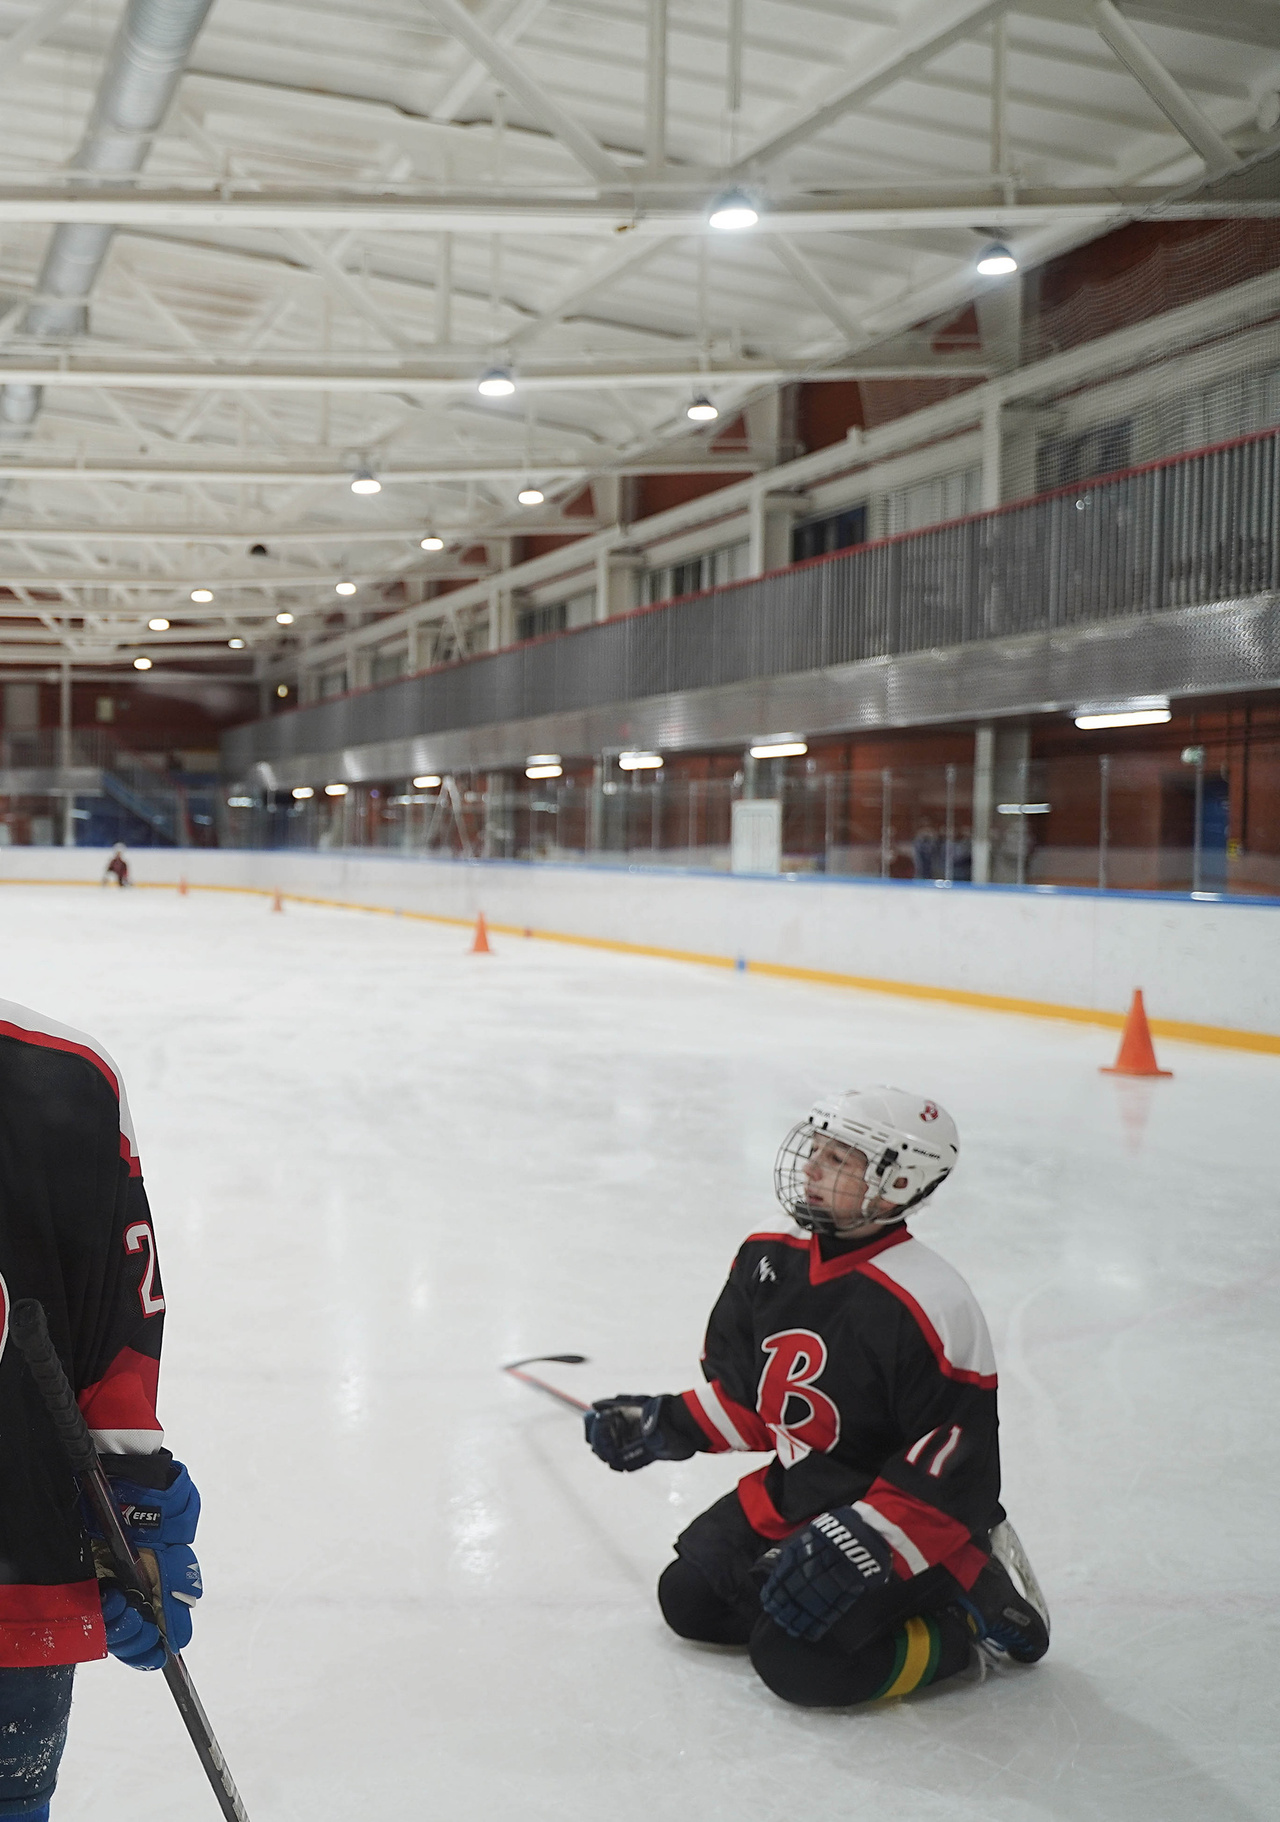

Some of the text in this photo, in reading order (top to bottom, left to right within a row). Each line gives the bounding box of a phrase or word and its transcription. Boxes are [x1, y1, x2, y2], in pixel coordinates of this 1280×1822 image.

[123, 1220, 166, 1319] 2
[756, 1328, 841, 1470] B
[904, 1424, 963, 1478] 11
[132, 1511, 157, 1521] EFSI
[811, 1511, 882, 1578] RRIOR
